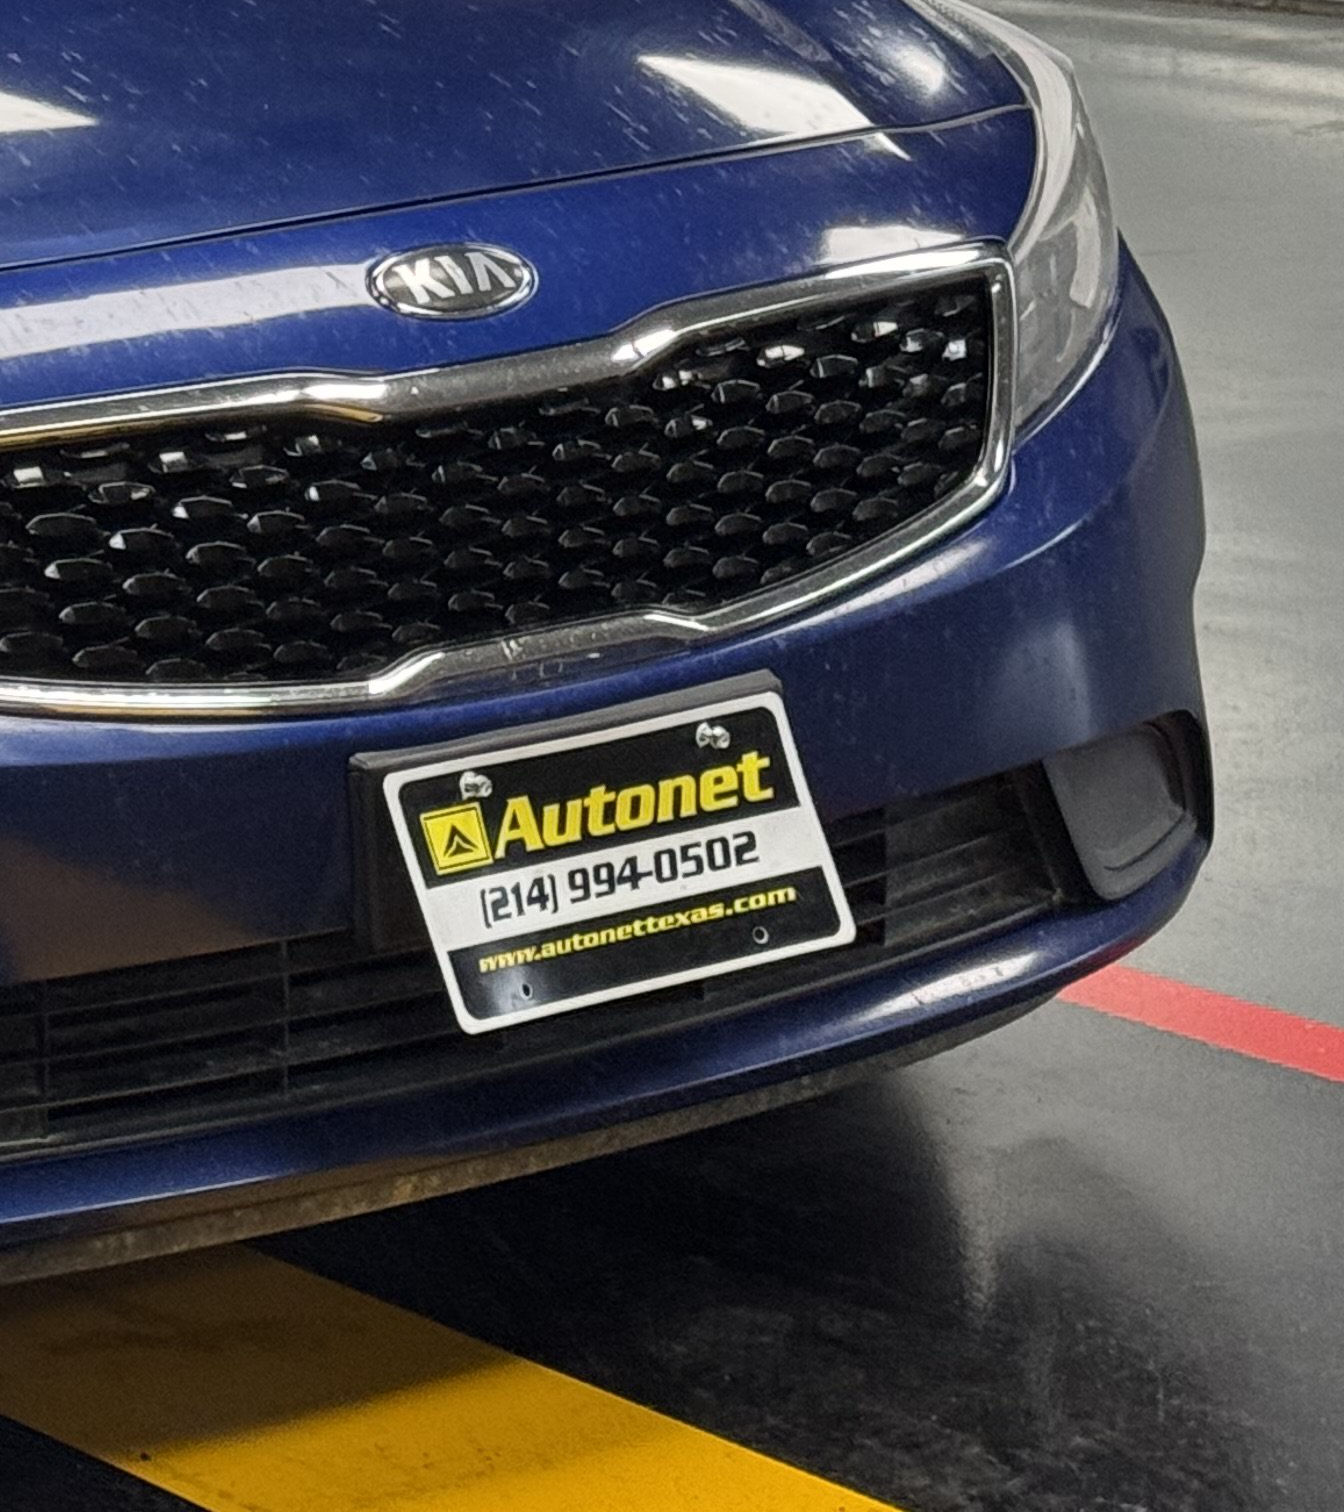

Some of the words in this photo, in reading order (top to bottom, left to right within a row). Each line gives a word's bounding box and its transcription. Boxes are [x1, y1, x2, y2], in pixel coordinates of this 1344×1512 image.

[391, 251, 517, 305] KIA
[494, 750, 775, 860] Autonet
[480, 872, 559, 929] (214)
[567, 830, 760, 904] 994-0502
[478, 886, 797, 973] www.autonettexas.com
